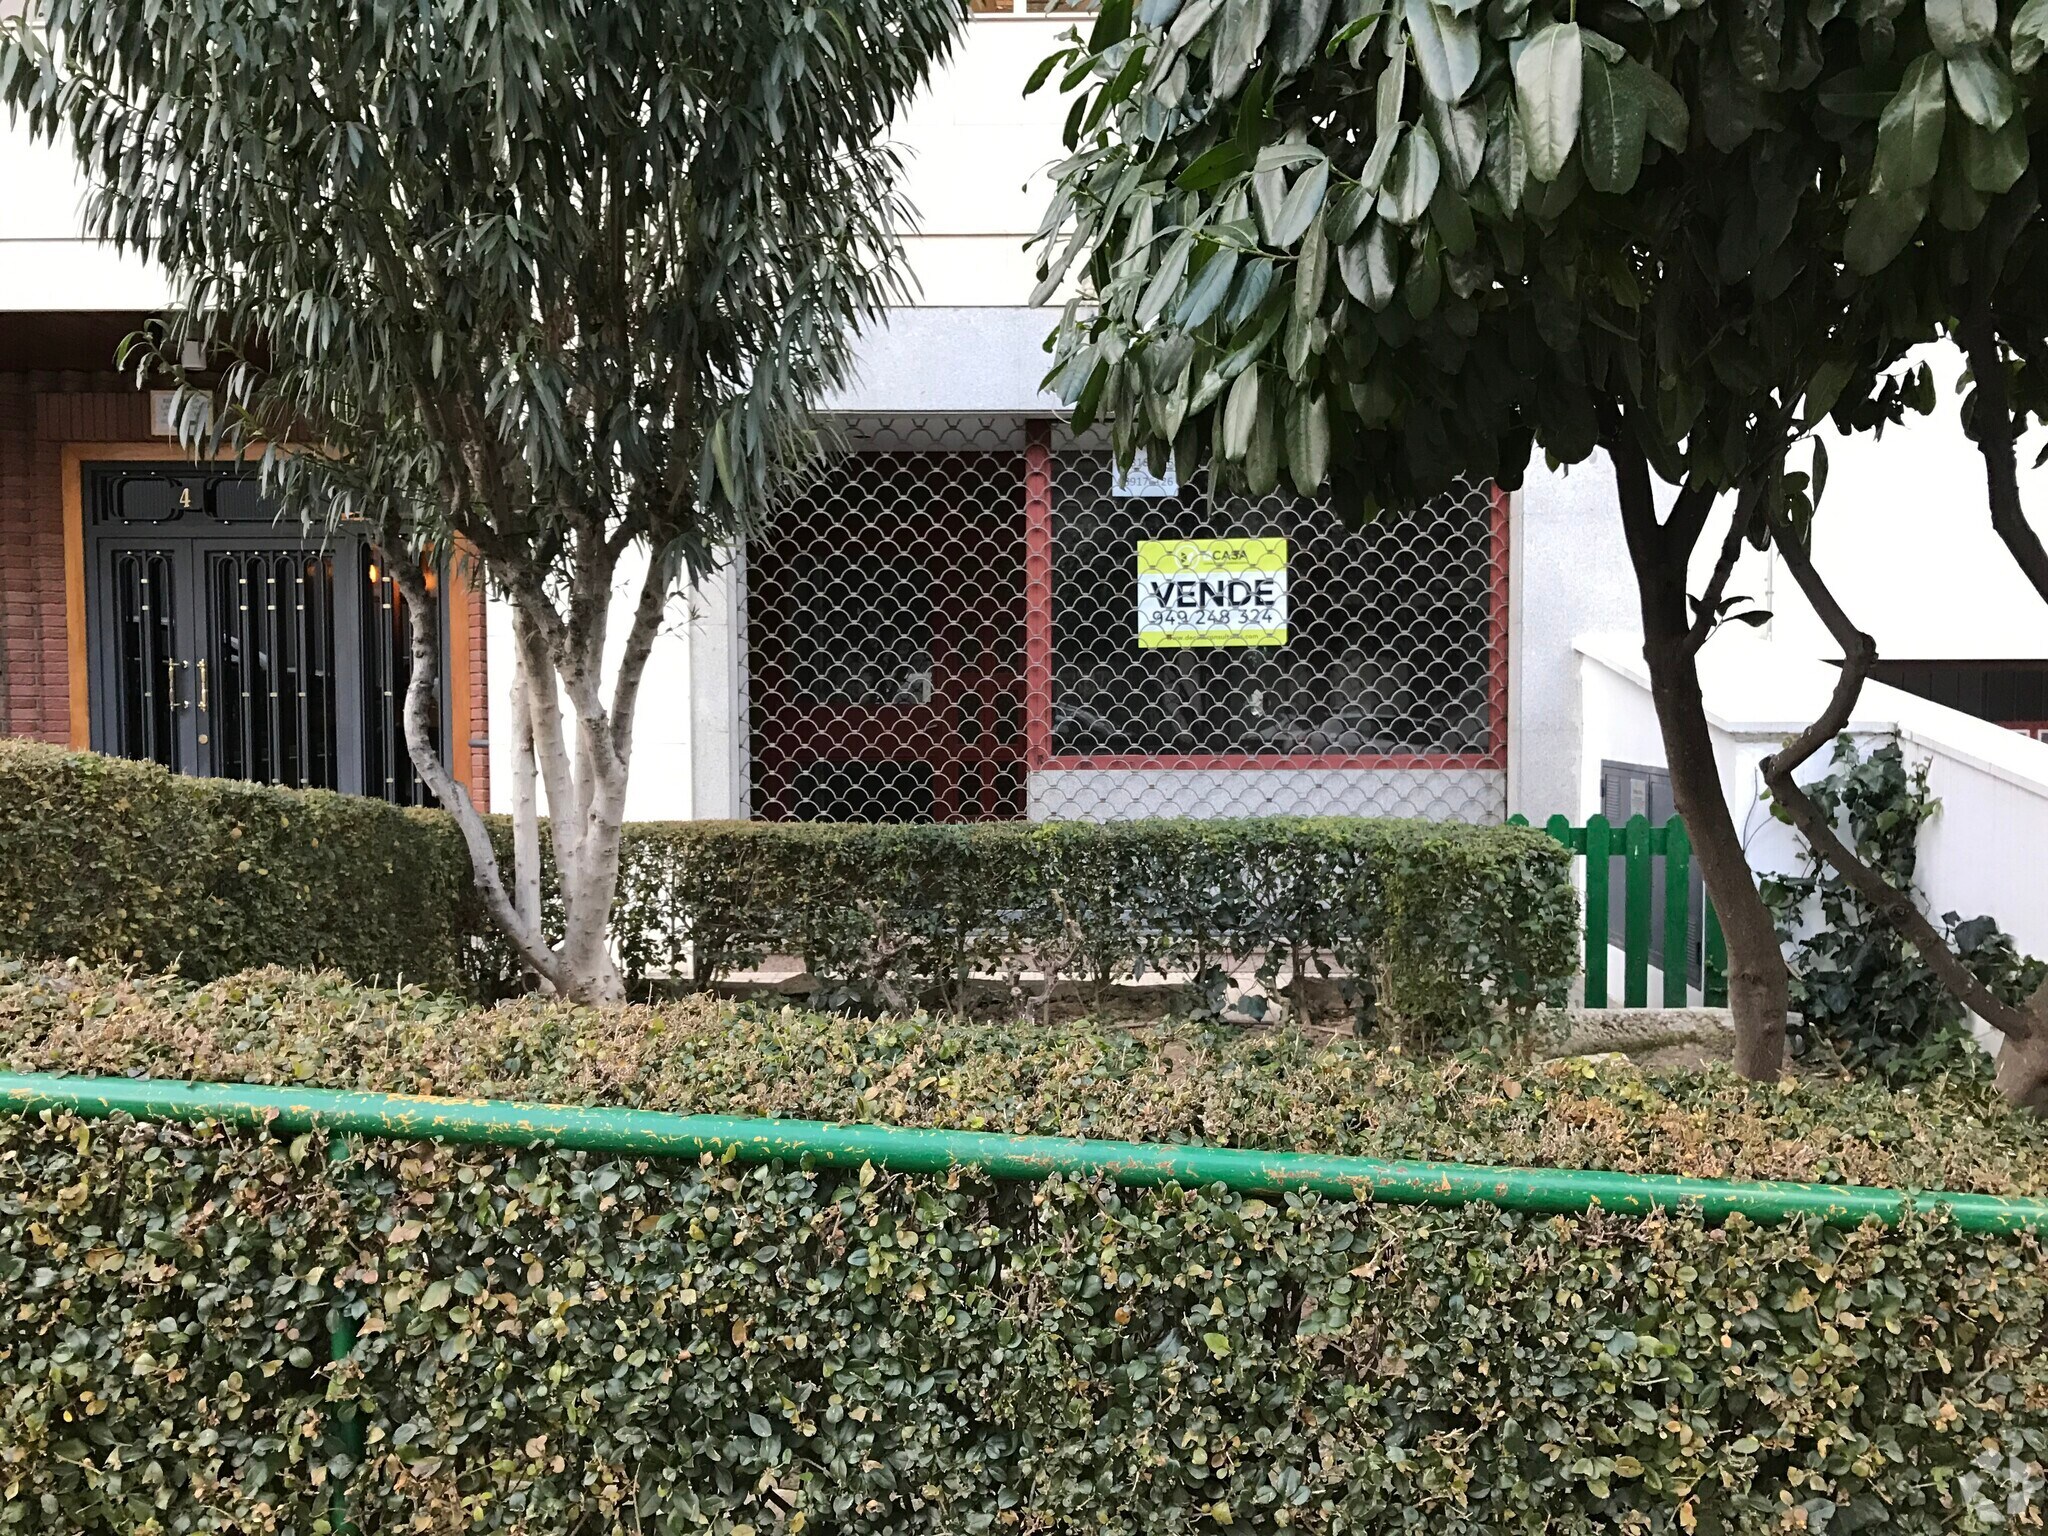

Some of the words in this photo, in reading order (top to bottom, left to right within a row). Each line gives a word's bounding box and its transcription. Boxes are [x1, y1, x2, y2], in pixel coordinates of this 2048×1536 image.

[180, 487, 191, 508] 4
[1151, 579, 1275, 608] VENDE
[1152, 610, 1188, 626] 949
[1195, 609, 1230, 625] 248
[1238, 608, 1272, 624] 324
